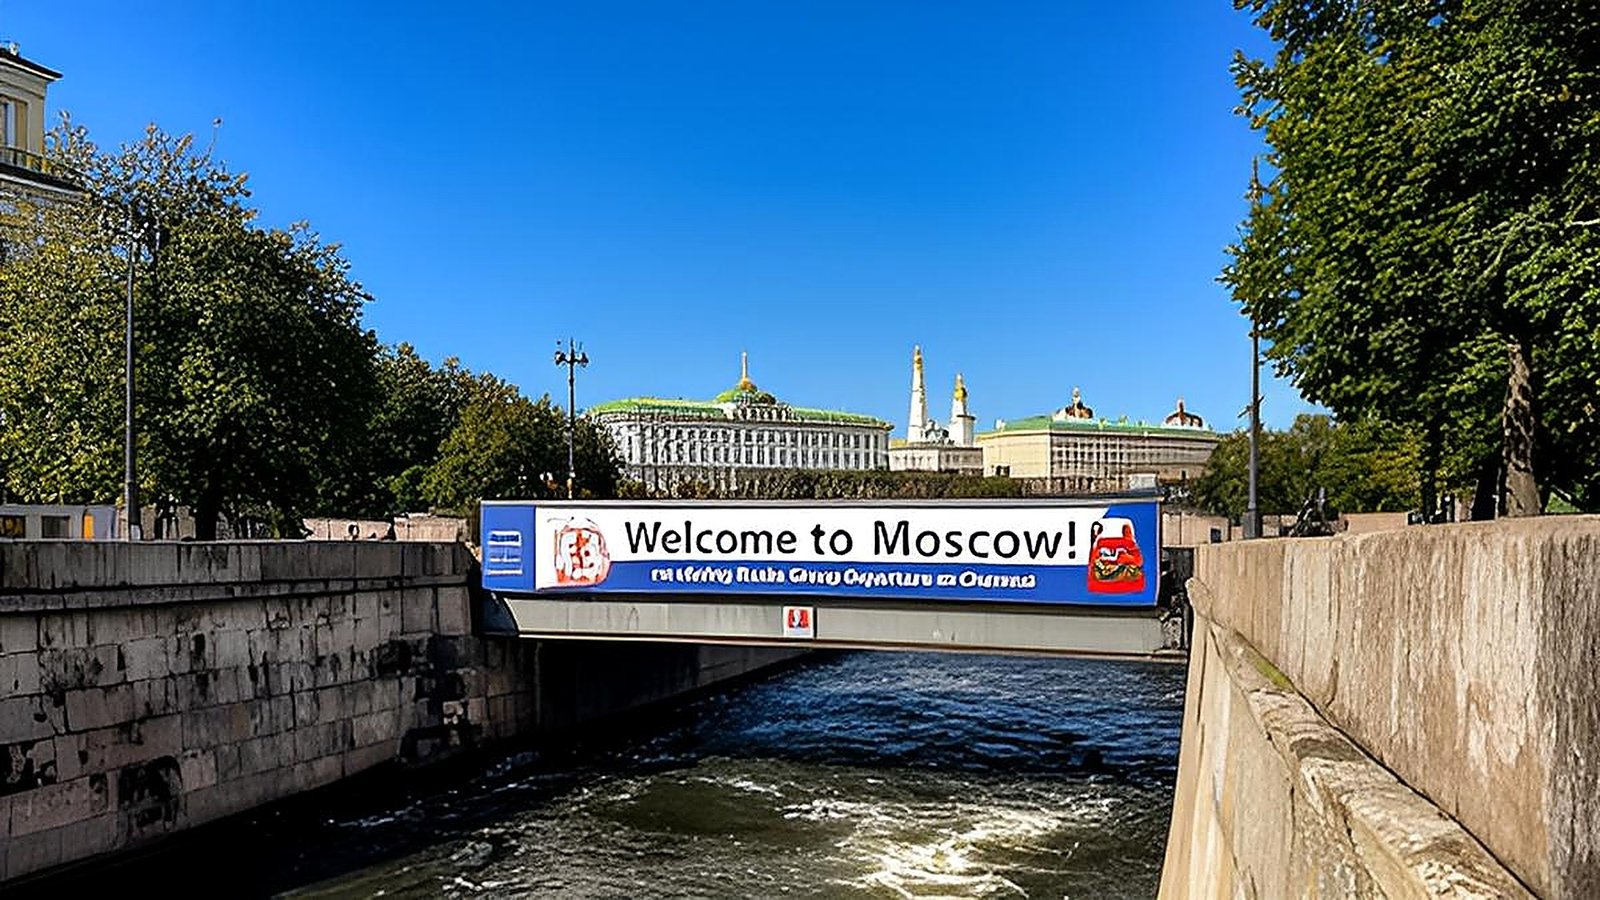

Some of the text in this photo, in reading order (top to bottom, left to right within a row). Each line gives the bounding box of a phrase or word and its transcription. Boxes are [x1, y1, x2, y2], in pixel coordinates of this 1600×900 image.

[624, 520, 1077, 560] Welcome to Moscow!
